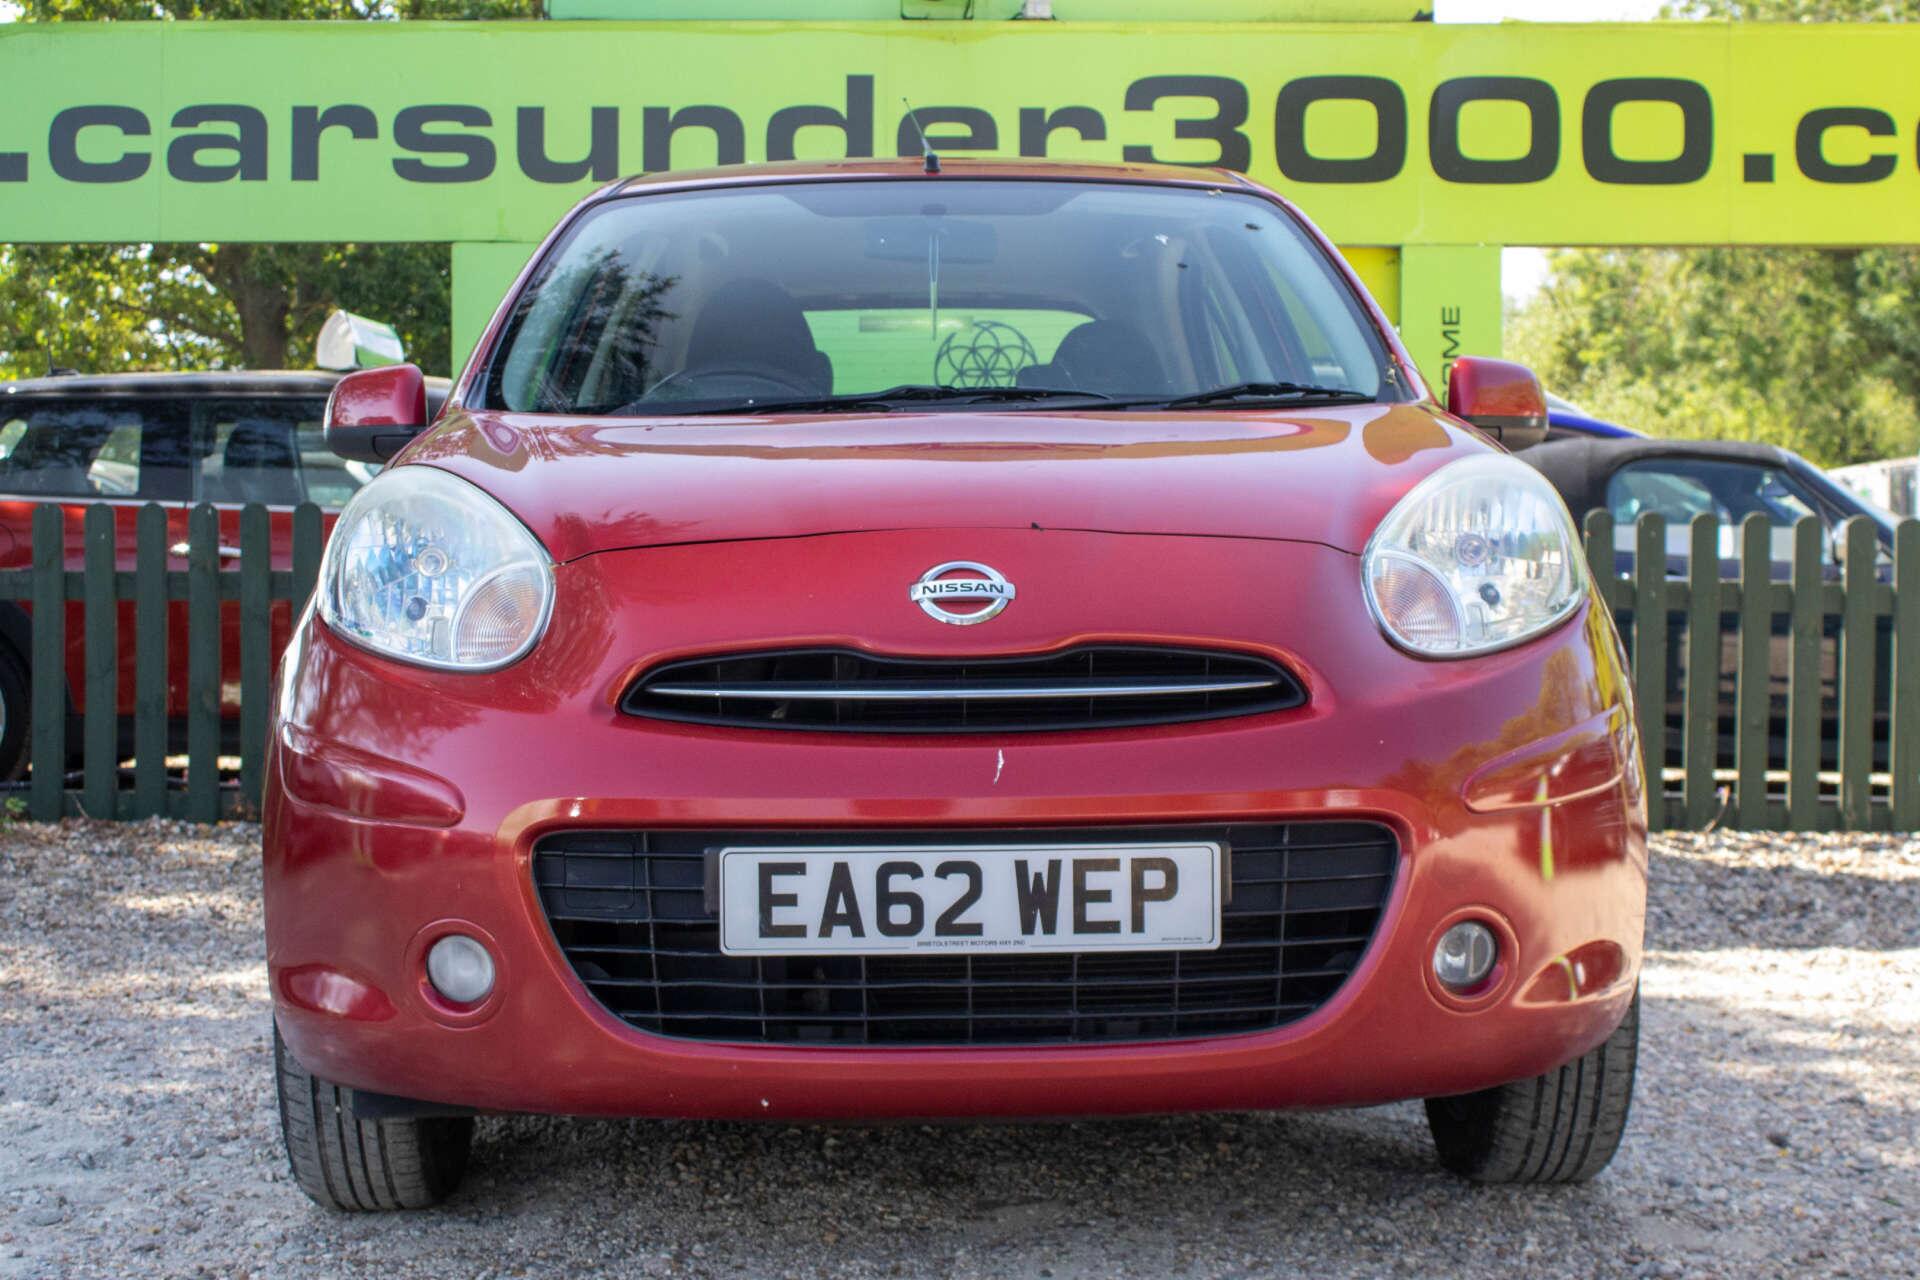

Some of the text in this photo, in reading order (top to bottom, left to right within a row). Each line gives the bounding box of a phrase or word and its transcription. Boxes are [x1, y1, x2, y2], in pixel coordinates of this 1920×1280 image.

[0, 75, 1920, 184] .carsunder3000.c
[922, 583, 1005, 595] NISSAN
[757, 857, 1180, 939] EA62 WEP
